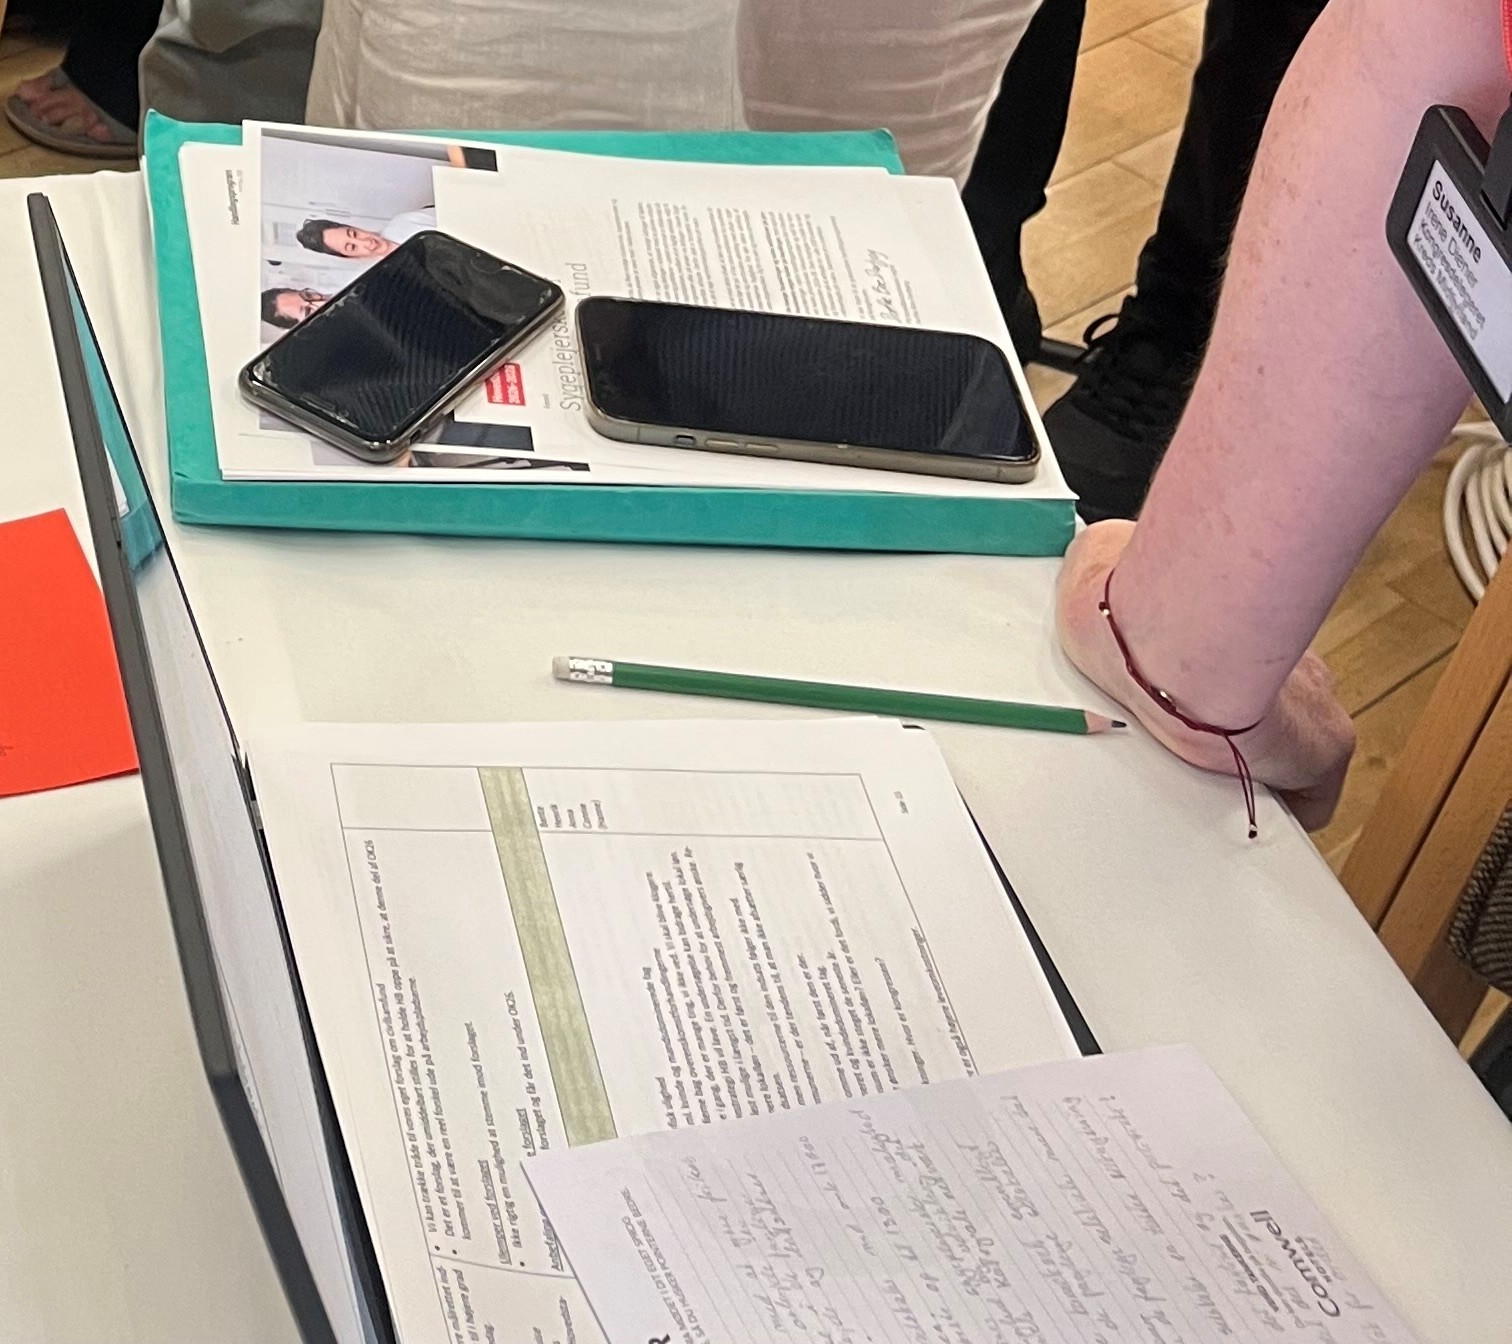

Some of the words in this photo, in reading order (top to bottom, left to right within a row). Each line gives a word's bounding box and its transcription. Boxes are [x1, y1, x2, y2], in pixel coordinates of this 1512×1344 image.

[1431, 180, 1482, 264] Susanne
[547, 310, 585, 411] Sygeplejersk
[1250, 1209, 1341, 1318] Comwell
